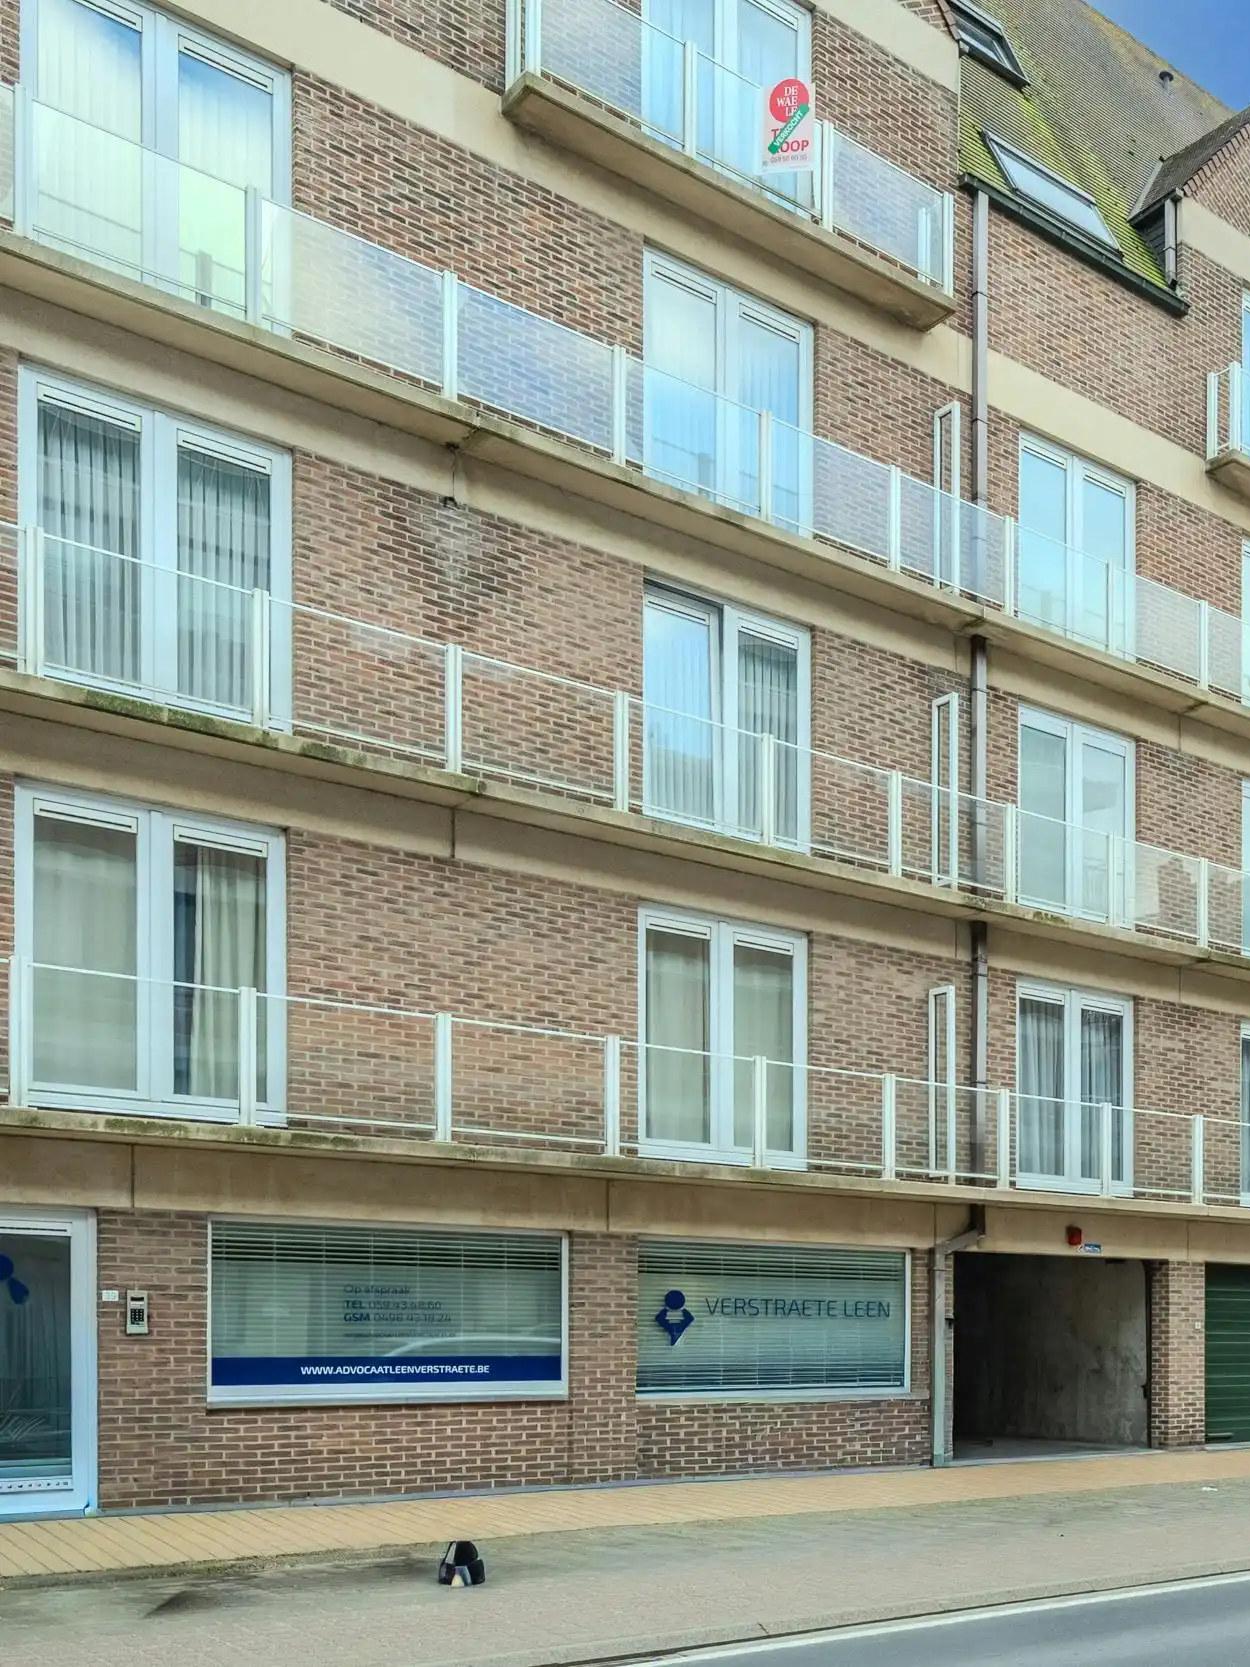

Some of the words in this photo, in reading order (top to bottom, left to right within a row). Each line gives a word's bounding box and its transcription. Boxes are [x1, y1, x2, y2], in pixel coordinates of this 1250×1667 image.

[784, 85, 798, 96] DE
[776, 95, 798, 107] WAE
[773, 110, 804, 147] VERKOCHT
[776, 139, 809, 154] OOP
[343, 1284, 361, 1295] Op
[345, 1300, 366, 1310] TEL
[705, 1297, 837, 1317] VERSTRAETE
[843, 1301, 890, 1318] LEEN
[344, 1312, 370, 1322] GSM
[300, 1365, 490, 1375] WWW.ADVOCAATLEENVERSTRAETE.BE
